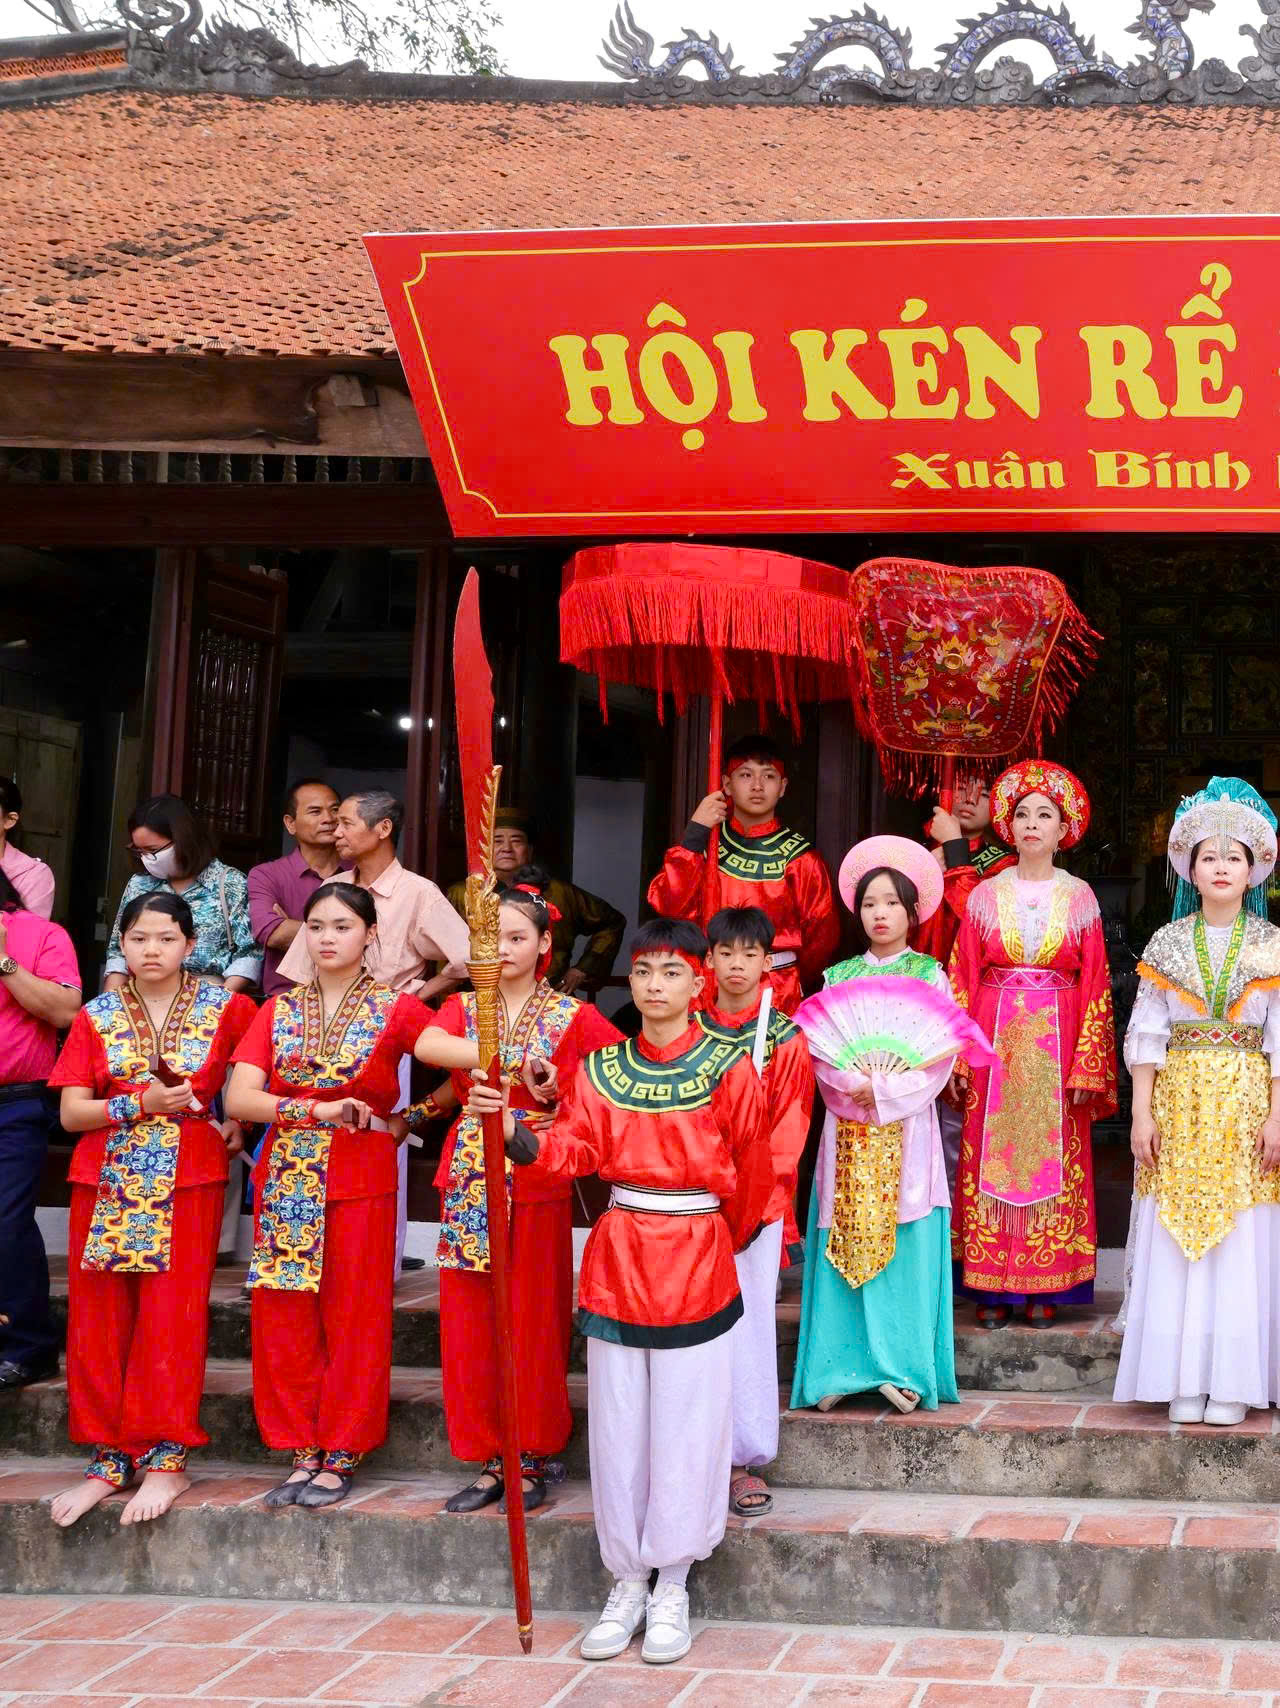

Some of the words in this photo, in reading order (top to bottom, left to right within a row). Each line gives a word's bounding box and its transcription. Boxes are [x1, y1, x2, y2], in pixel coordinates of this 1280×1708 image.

[548, 302, 768, 452] HỘI
[789, 298, 1043, 422] KÉN
[1078, 262, 1243, 420] RỂ
[890, 450, 1066, 489] Xuân
[1087, 448, 1251, 492] Bính
